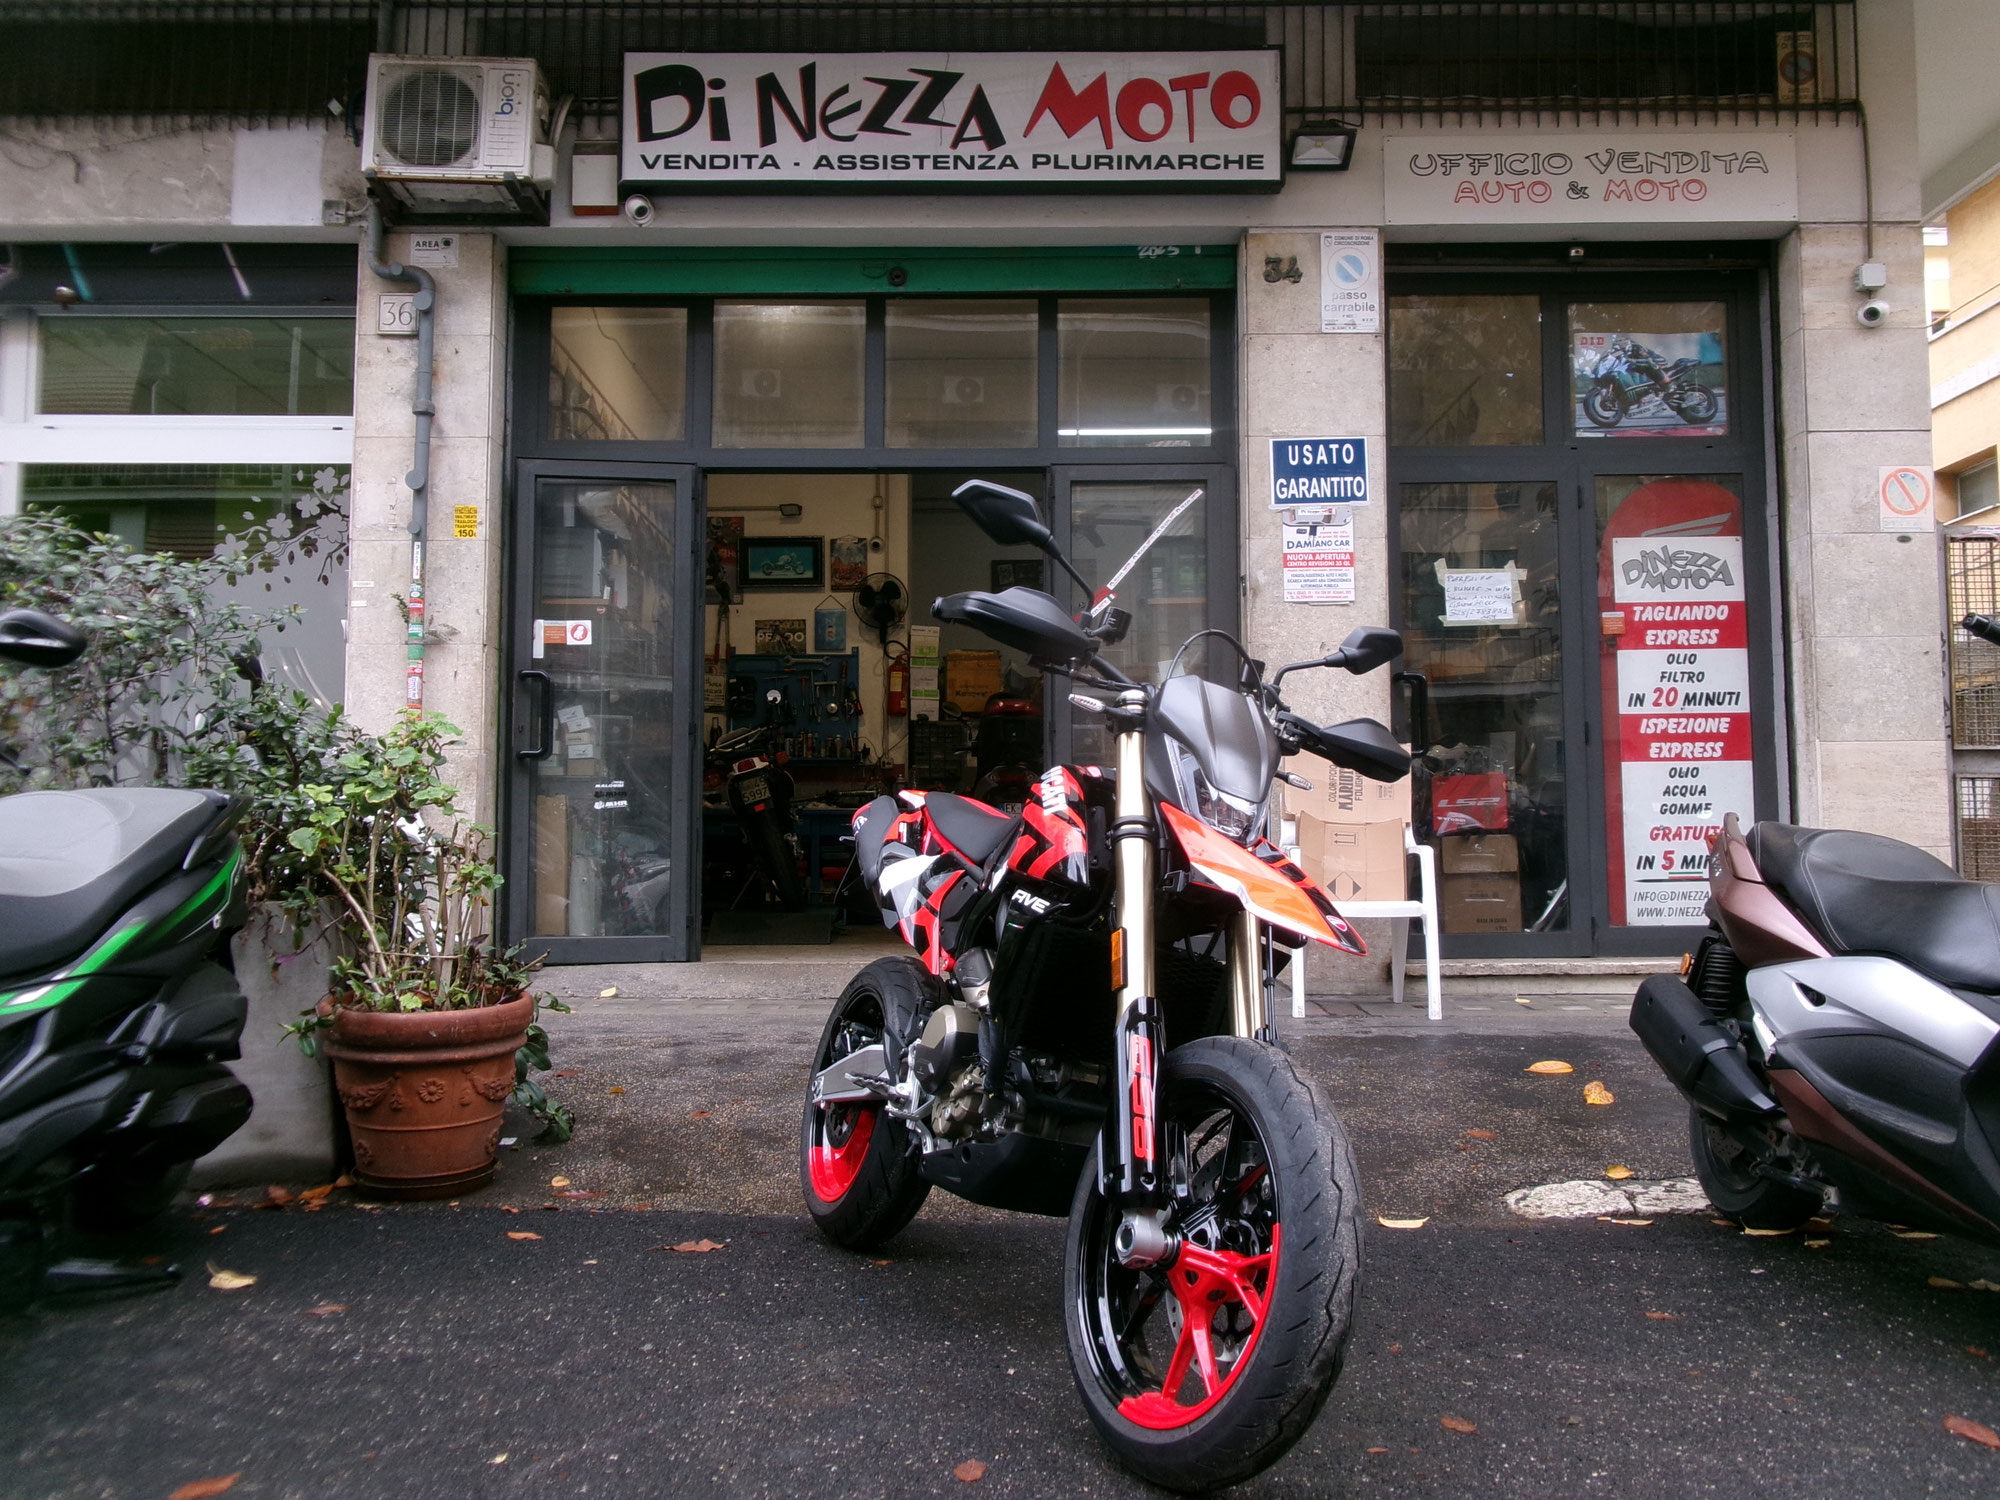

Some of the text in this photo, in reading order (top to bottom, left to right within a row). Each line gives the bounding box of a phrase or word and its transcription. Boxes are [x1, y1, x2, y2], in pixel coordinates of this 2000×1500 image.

[495, 74, 515, 115] bion
[1023, 61, 1261, 150] MOTO
[640, 154, 781, 170] VENDITA
[813, 154, 1019, 170] ASSISTENZA
[1032, 154, 1264, 170] PLURIMARCHE
[1410, 148, 1769, 176] UFFICIO VENDITA
[1454, 179, 1707, 203] AUTO & MOTO
[1263, 255, 1303, 284] 34
[1332, 292, 1367, 303] passo
[382, 302, 413, 326] 36
[1324, 302, 1375, 312] carrabile
[1580, 337, 1605, 345] DID
[1288, 443, 1354, 466] USATO
[1276, 476, 1365, 499] GARANTITO
[1287, 540, 1333, 549] DAMIANO
[1287, 553, 1314, 561] NUOVA
[1640, 568, 1711, 592] MOTO
[1633, 605, 1729, 622] TAGLIANDO
[1645, 629, 1720, 645] EXPRESS
[1667, 653, 1697, 665] OLIO
[1660, 671, 1705, 683] FILTRO
[1628, 687, 1741, 707] IN 20 MINUTI
[1640, 717, 1731, 734] ISPEZIONE
[1649, 742, 1724, 759] EXPRESS
[1668, 767, 1700, 779] OLIO
[1040, 765, 1068, 816] UCATI
[1328, 764, 1337, 803] COLORIFICIO
[1338, 768, 1354, 811] MARIUT
[1354, 771, 1363, 801] FOLIGN
[1663, 785, 1707, 797] ACQUA
[1437, 797, 1501, 808] LS2
[1636, 855, 1655, 870] IN
[1661, 850, 1675, 871] 5
[1633, 891, 1710, 903] INFO@DINEZZA
[1637, 907, 1706, 918] WWW.DINEZZA
